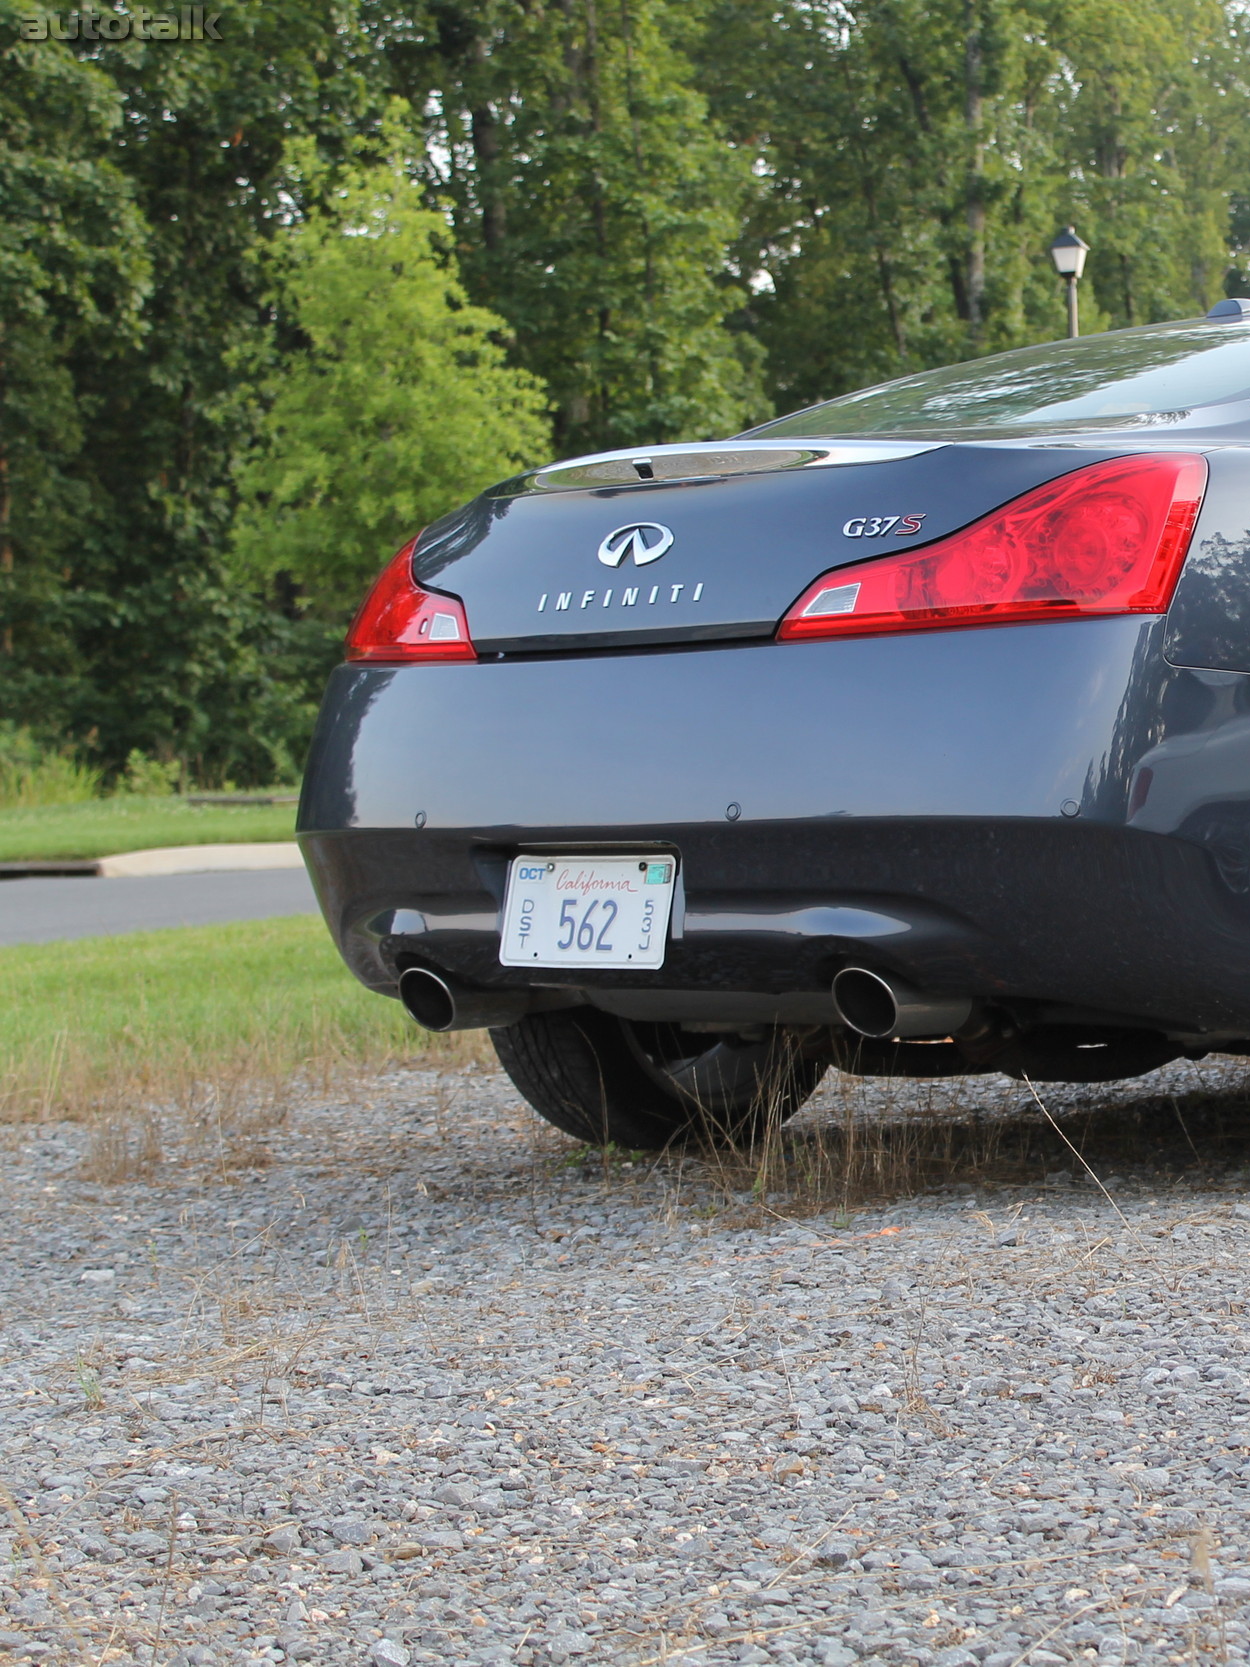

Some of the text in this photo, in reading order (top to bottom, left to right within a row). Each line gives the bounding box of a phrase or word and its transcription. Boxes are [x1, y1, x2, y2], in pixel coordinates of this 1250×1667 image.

[842, 513, 927, 538] G37S
[537, 582, 704, 613] INFINITI
[519, 867, 546, 881] OCT
[556, 868, 638, 896] California
[557, 899, 619, 951] 562
